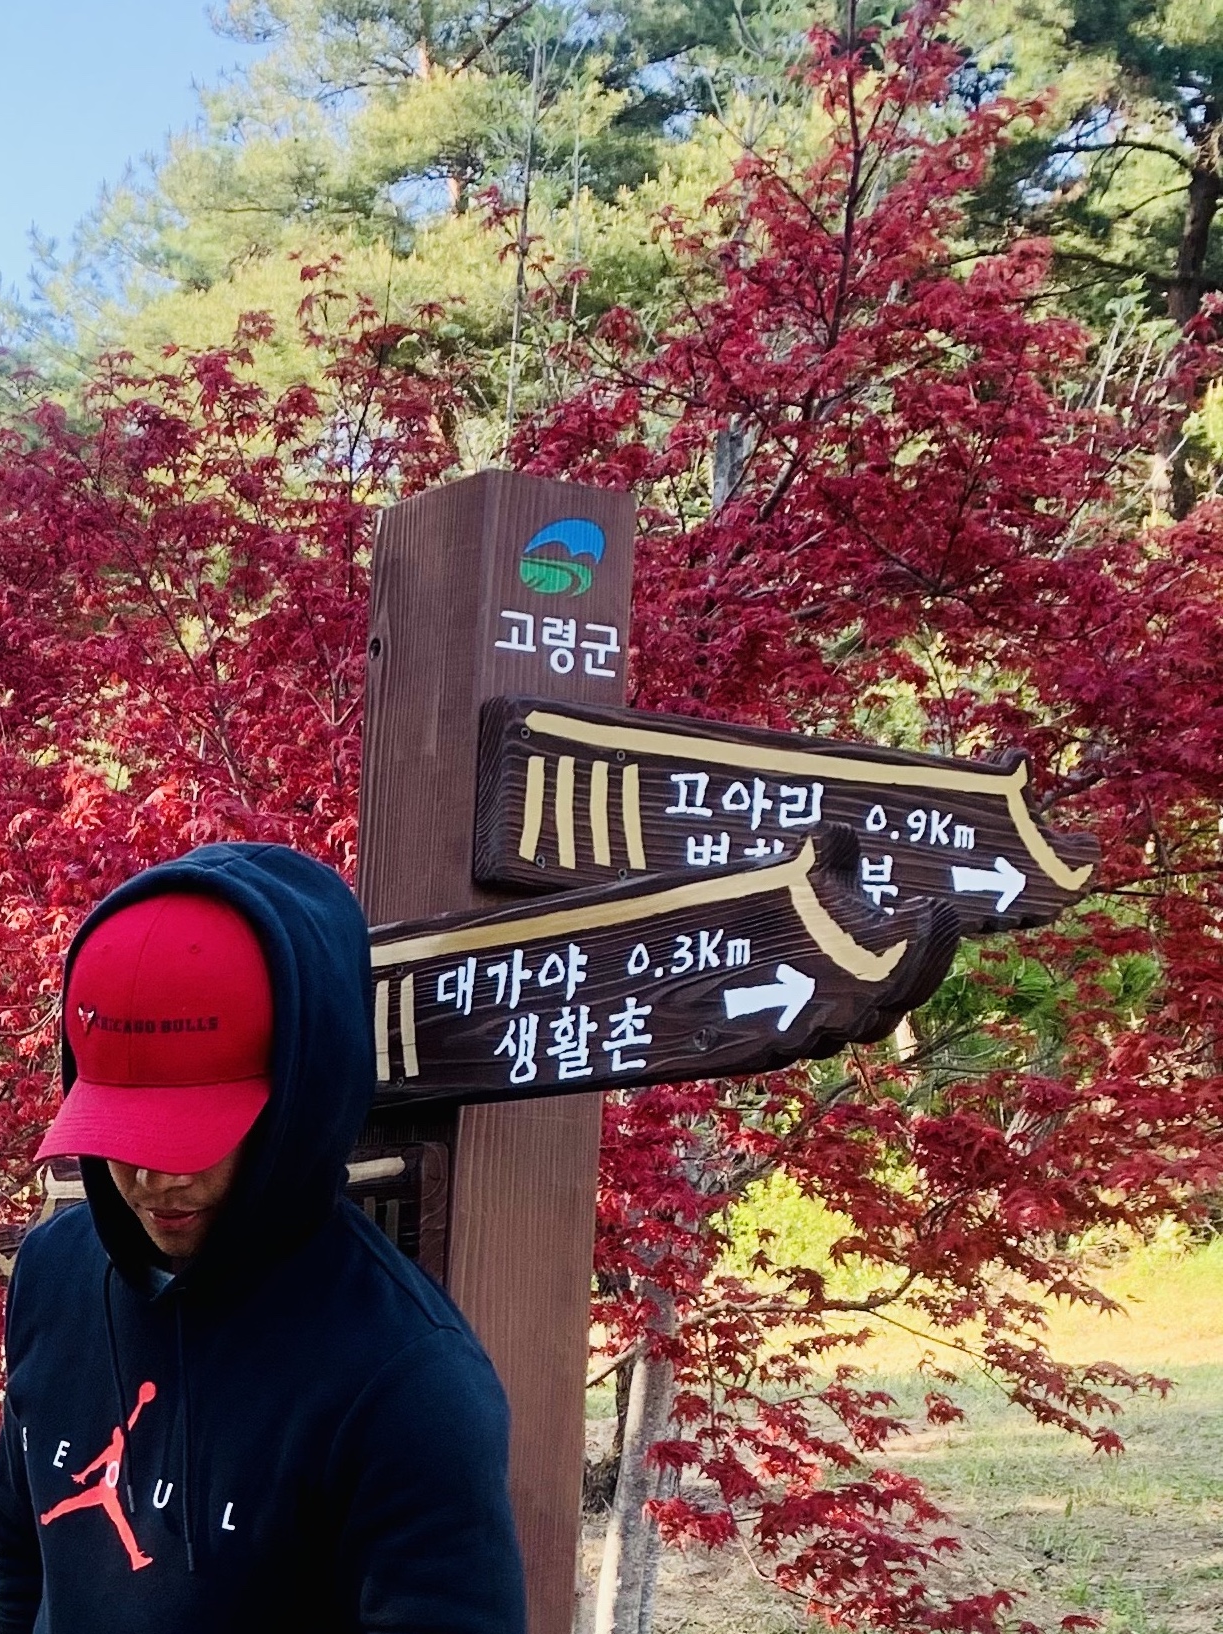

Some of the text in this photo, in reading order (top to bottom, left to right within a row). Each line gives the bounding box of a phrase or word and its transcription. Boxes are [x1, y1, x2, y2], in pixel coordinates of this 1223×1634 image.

[494, 610, 621, 678] 고령군
[665, 772, 975, 850] 고아리 0.9Km
[437, 928, 751, 1017] 대가야 0.3Km
[160, 1016, 218, 1033] BULLS
[493, 996, 653, 1084] 생활촌
